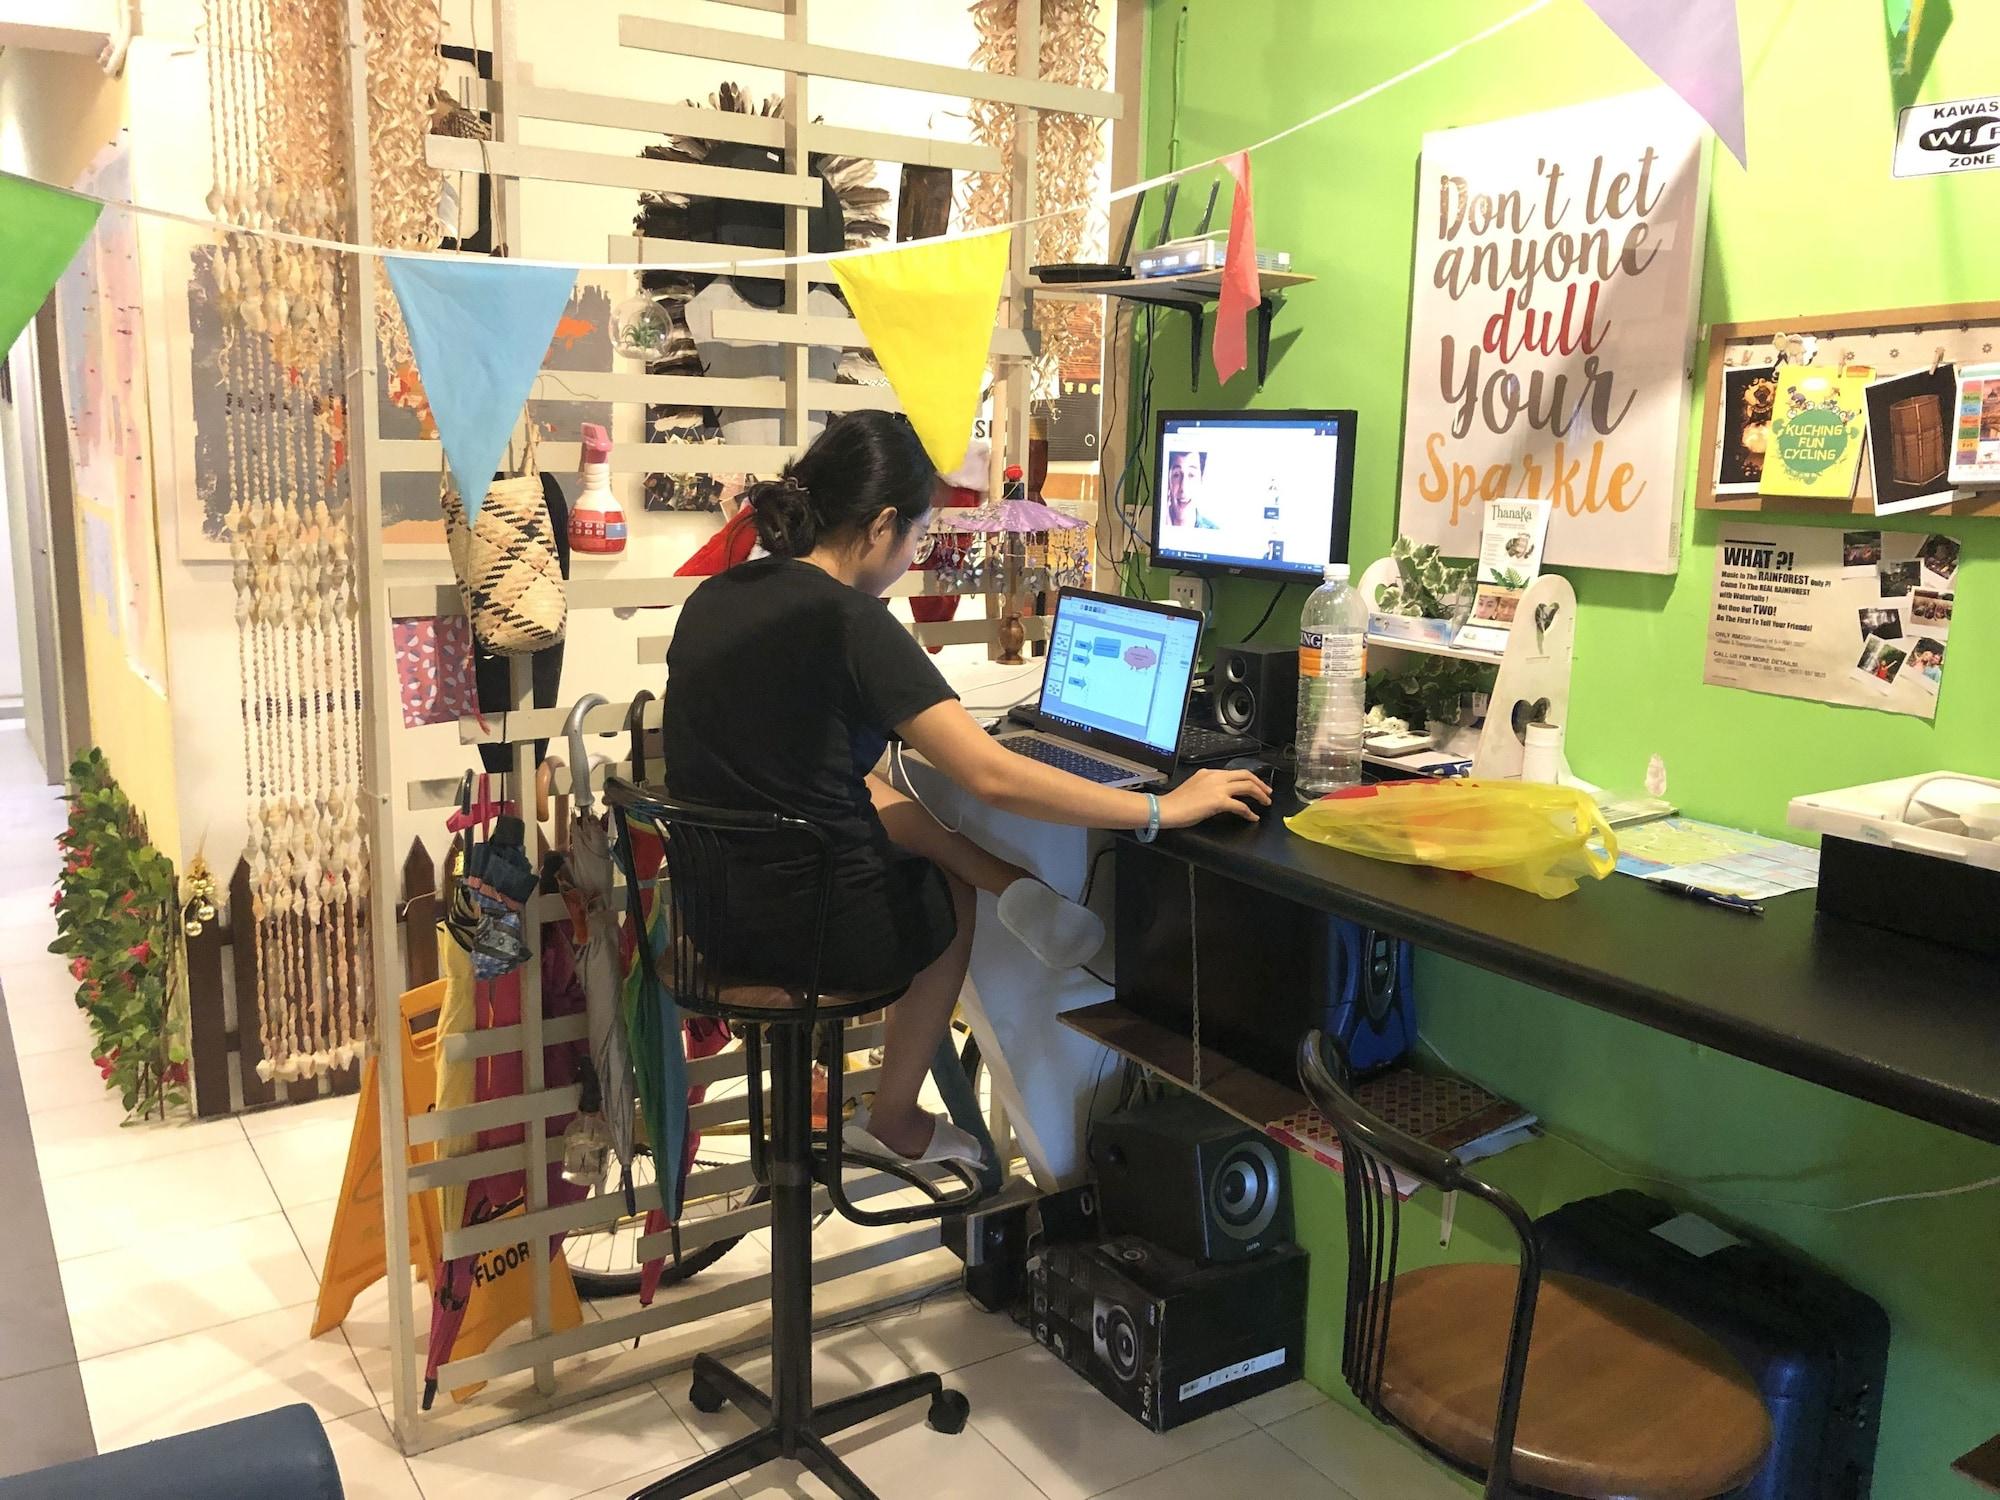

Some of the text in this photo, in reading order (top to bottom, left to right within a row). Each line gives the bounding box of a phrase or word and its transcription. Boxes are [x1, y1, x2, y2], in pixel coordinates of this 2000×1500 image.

[1949, 154, 1995, 168] ZONE
[1438, 145, 1665, 242] Don't let
[1433, 221, 1662, 311] anyone
[1482, 280, 1611, 364] dull
[1786, 424, 1843, 436] KUCHING
[1798, 437, 1825, 448] FUN
[1784, 448, 1836, 460] CYCLING
[1418, 431, 1647, 527] Sparkle
[1724, 547, 1794, 571] WHAT ?!
[1758, 571, 1810, 586] RAINFOREST
[1774, 586, 1810, 596] RAINFOREST
[1753, 604, 1777, 616] TWO!
[1752, 656, 1769, 664] MORE
[475, 1241, 530, 1287] FLOOR
